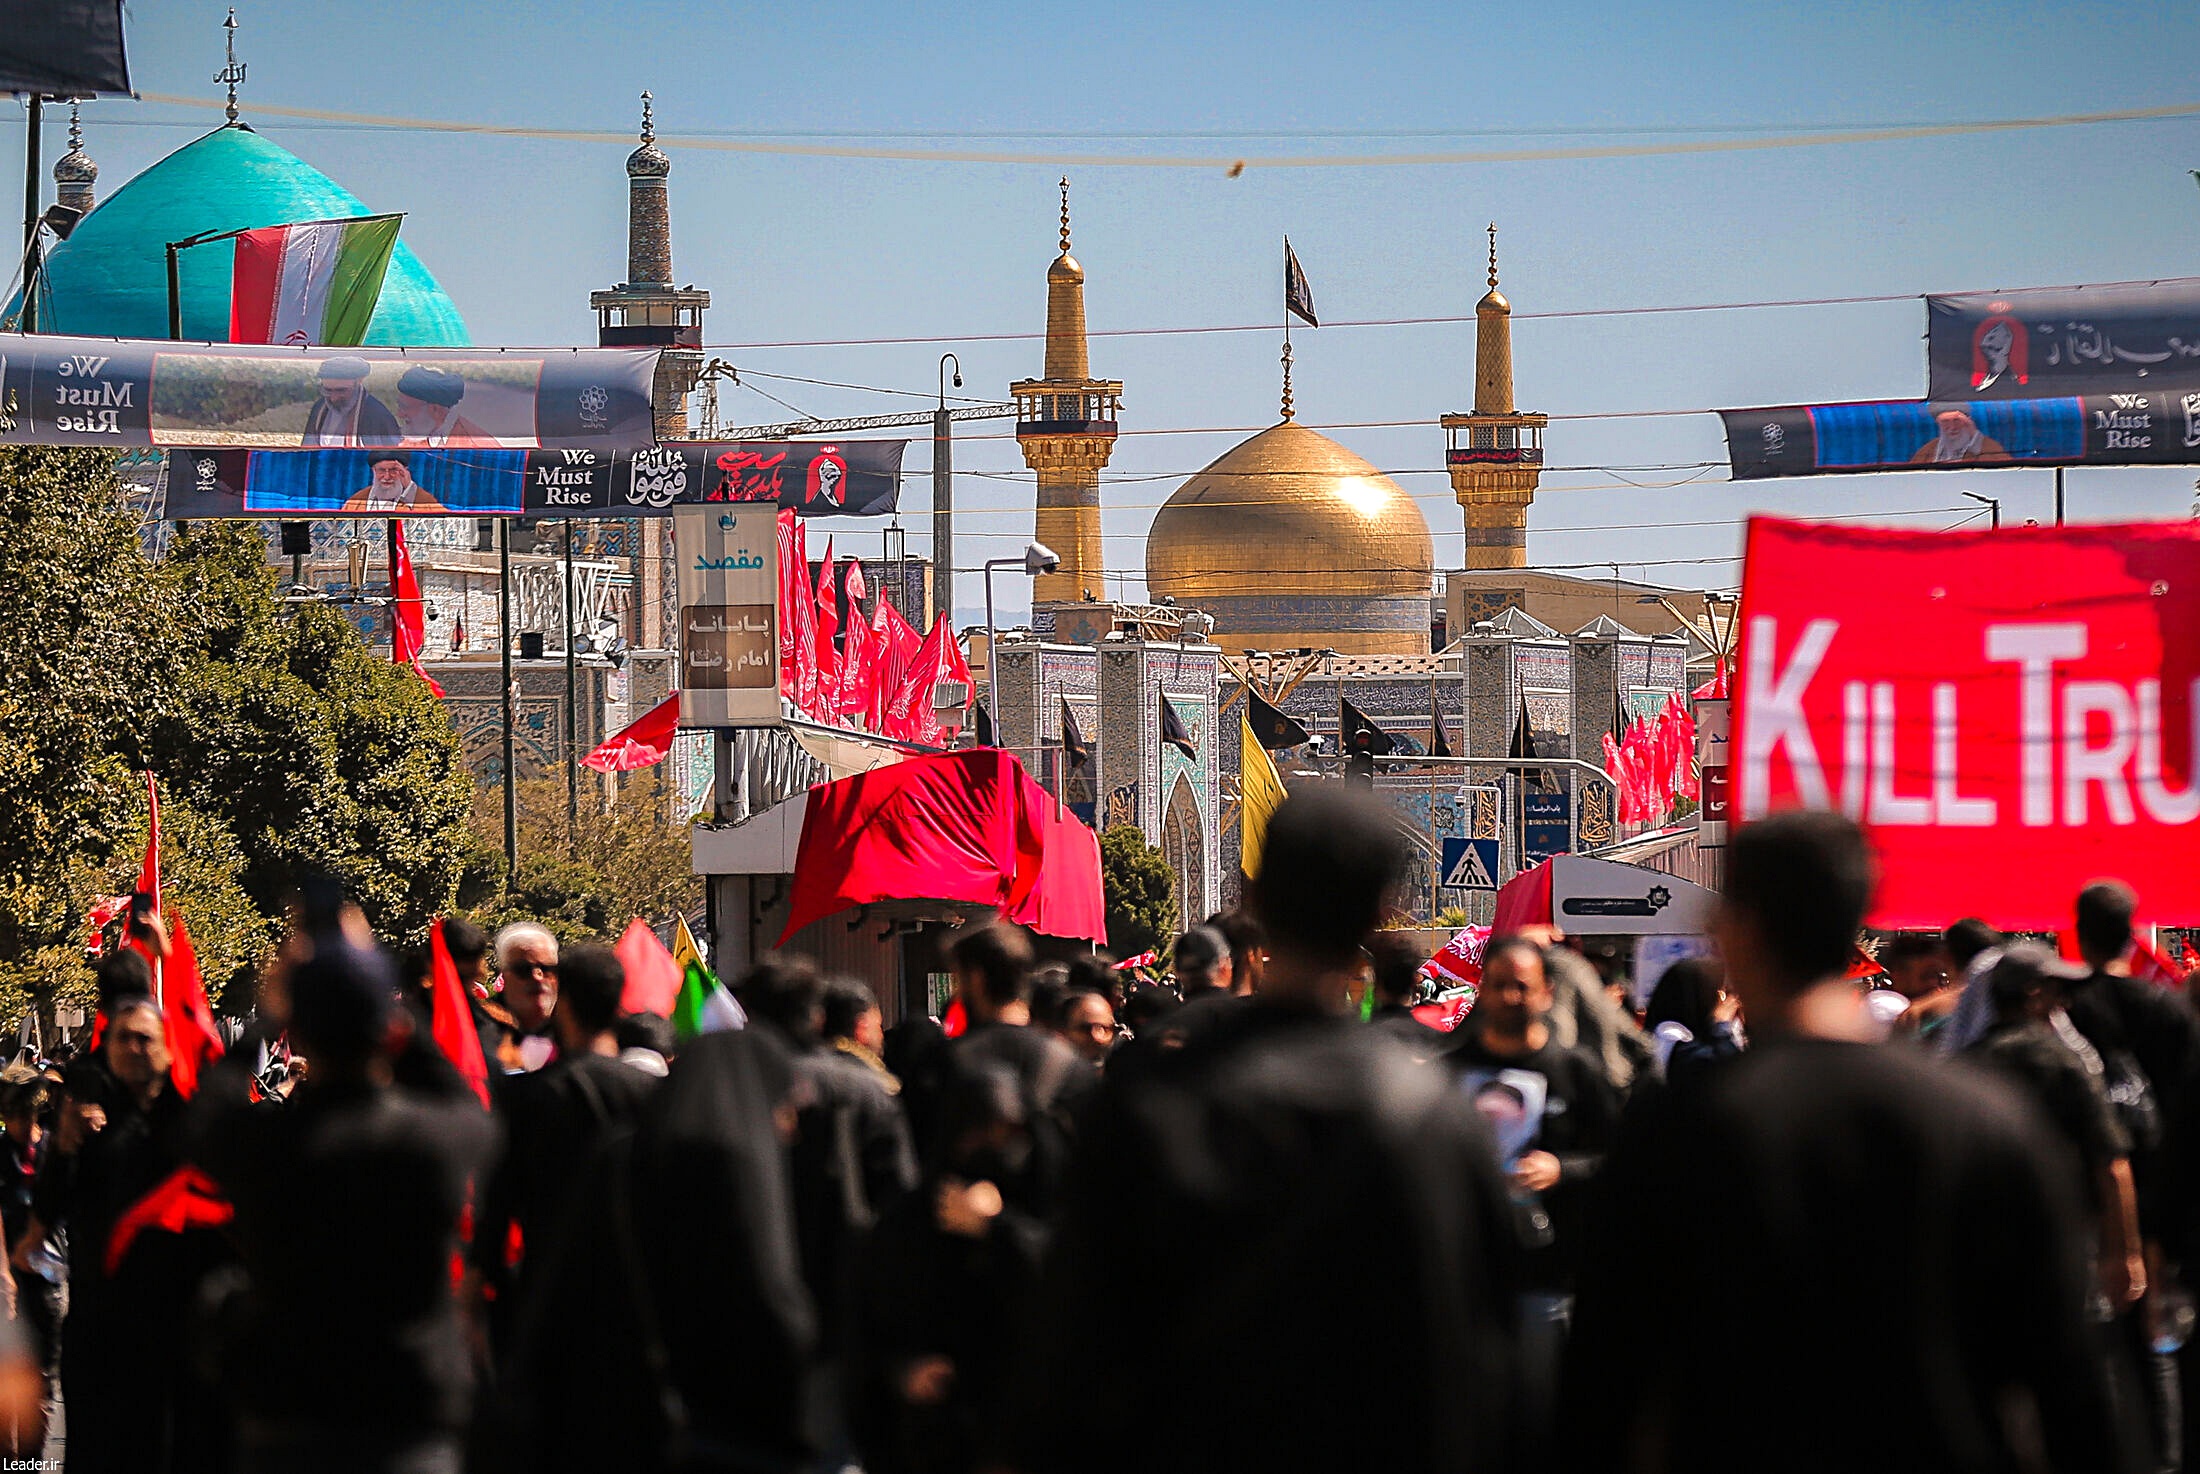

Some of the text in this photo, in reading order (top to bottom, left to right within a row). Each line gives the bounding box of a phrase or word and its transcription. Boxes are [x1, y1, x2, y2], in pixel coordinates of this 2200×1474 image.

[2107, 393, 2149, 410] We
[2093, 409, 2152, 430] Must
[2104, 430, 2152, 449] Rise
[560, 449, 596, 465] We
[536, 466, 594, 486] Must
[544, 487, 592, 505] Rise
[693, 548, 764, 571] مقصد
[689, 613, 770, 638] پایانه
[689, 649, 733, 672] رضا
[737, 649, 769, 672] امام
